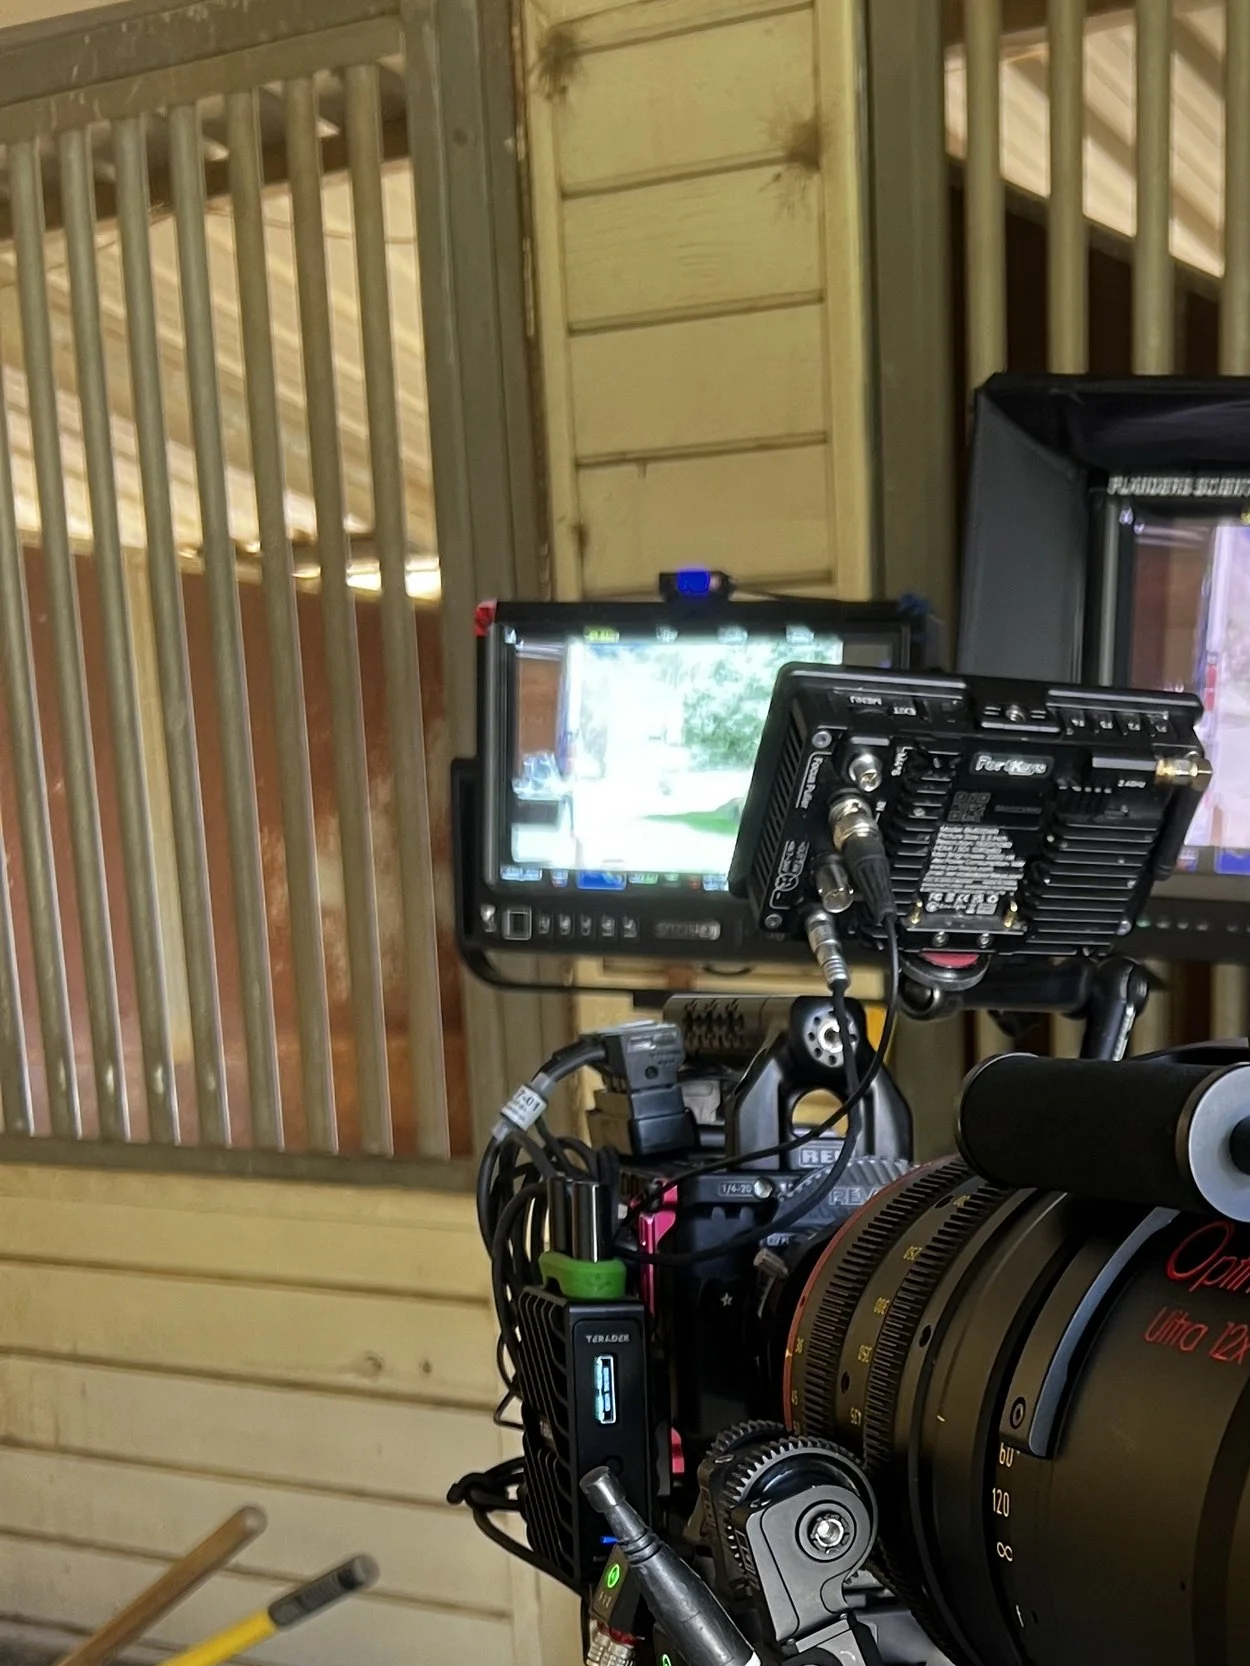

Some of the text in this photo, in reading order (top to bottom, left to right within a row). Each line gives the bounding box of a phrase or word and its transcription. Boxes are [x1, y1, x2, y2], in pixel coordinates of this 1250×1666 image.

[802, 1150, 840, 1164] RE
[586, 1333, 630, 1343] TERADEK
[1144, 1306, 1208, 1351] Ultra
[992, 1487, 1010, 1518] 120
